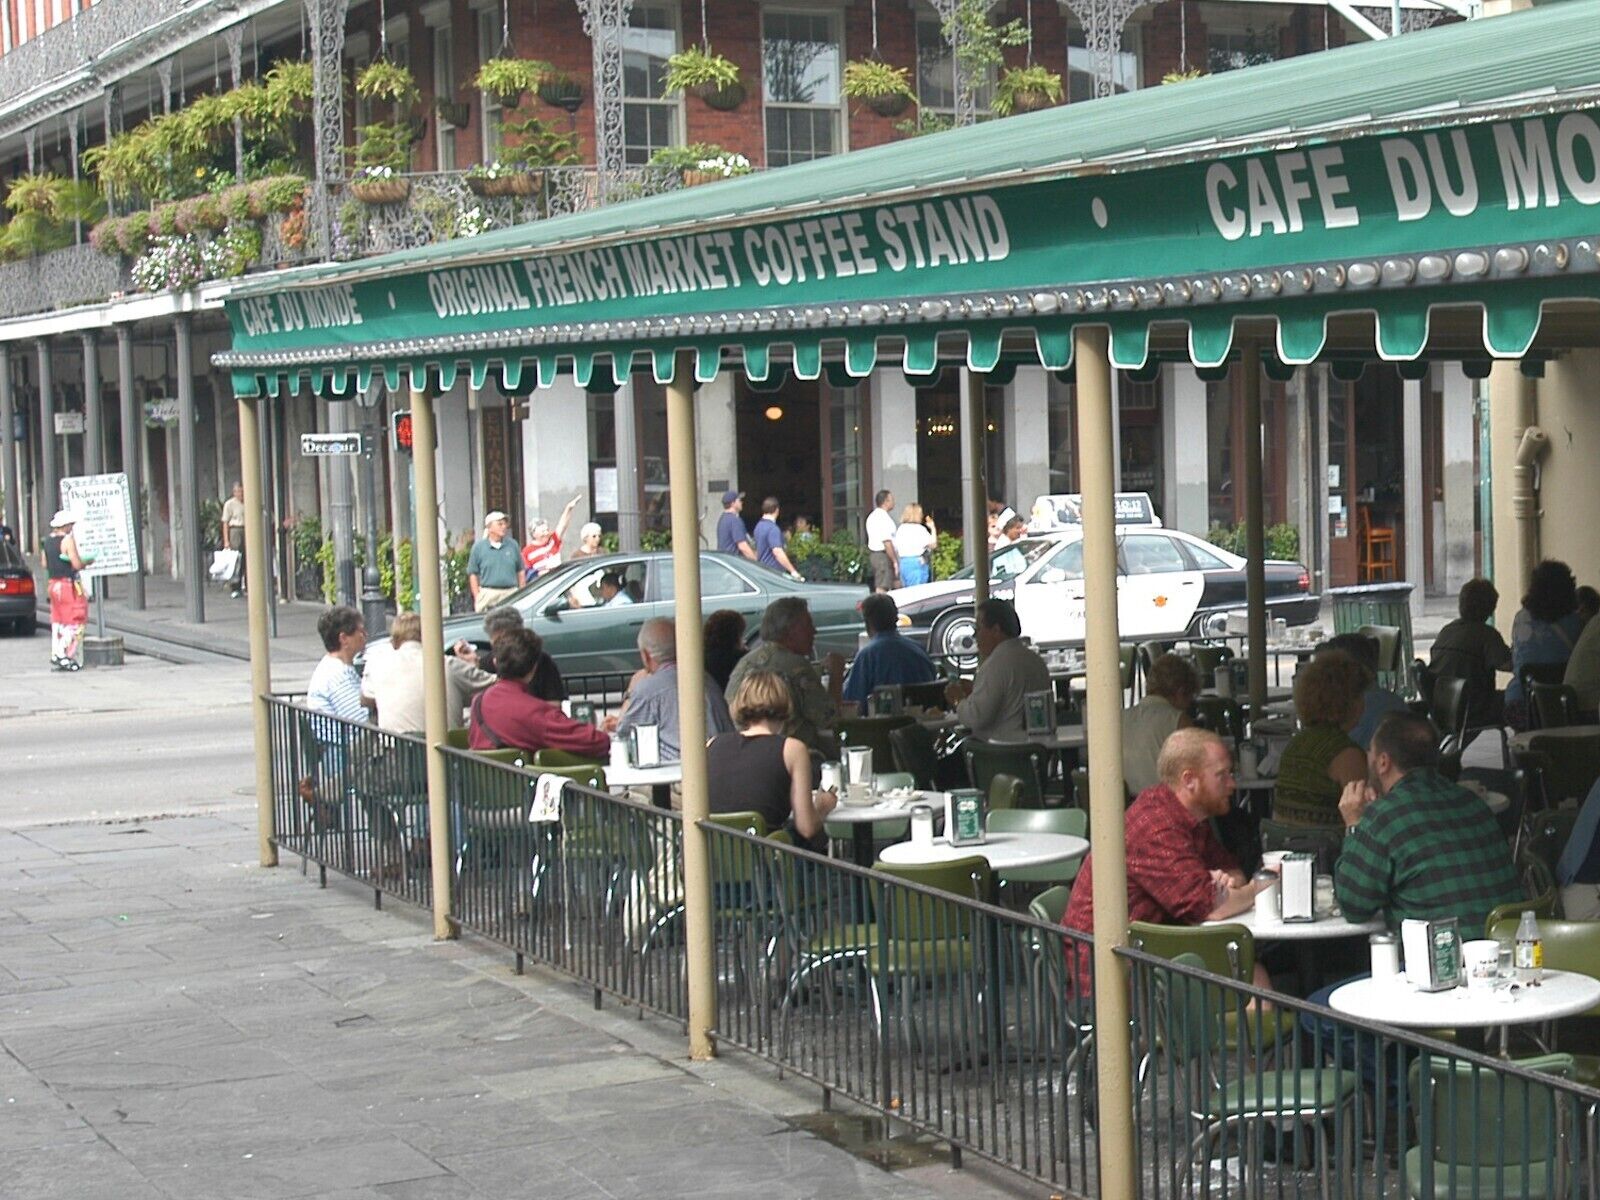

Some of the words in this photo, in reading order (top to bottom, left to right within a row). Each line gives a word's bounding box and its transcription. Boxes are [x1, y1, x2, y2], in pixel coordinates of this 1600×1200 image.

[239, 294, 280, 337] CAFE
[276, 290, 305, 332] DU
[299, 283, 363, 329] MONDE
[427, 262, 531, 319] ORIGINAL
[523, 247, 628, 308] FRENCH
[620, 231, 741, 297] MARKET
[743, 212, 878, 287] COFFEE
[875, 194, 1010, 272] STAND
[1205, 145, 1359, 241] CAFE
[1380, 129, 1479, 222] DU
[303, 442, 355, 453] Decur
[71, 489, 120, 499] Pedestrian
[87, 498, 107, 507] Mall
